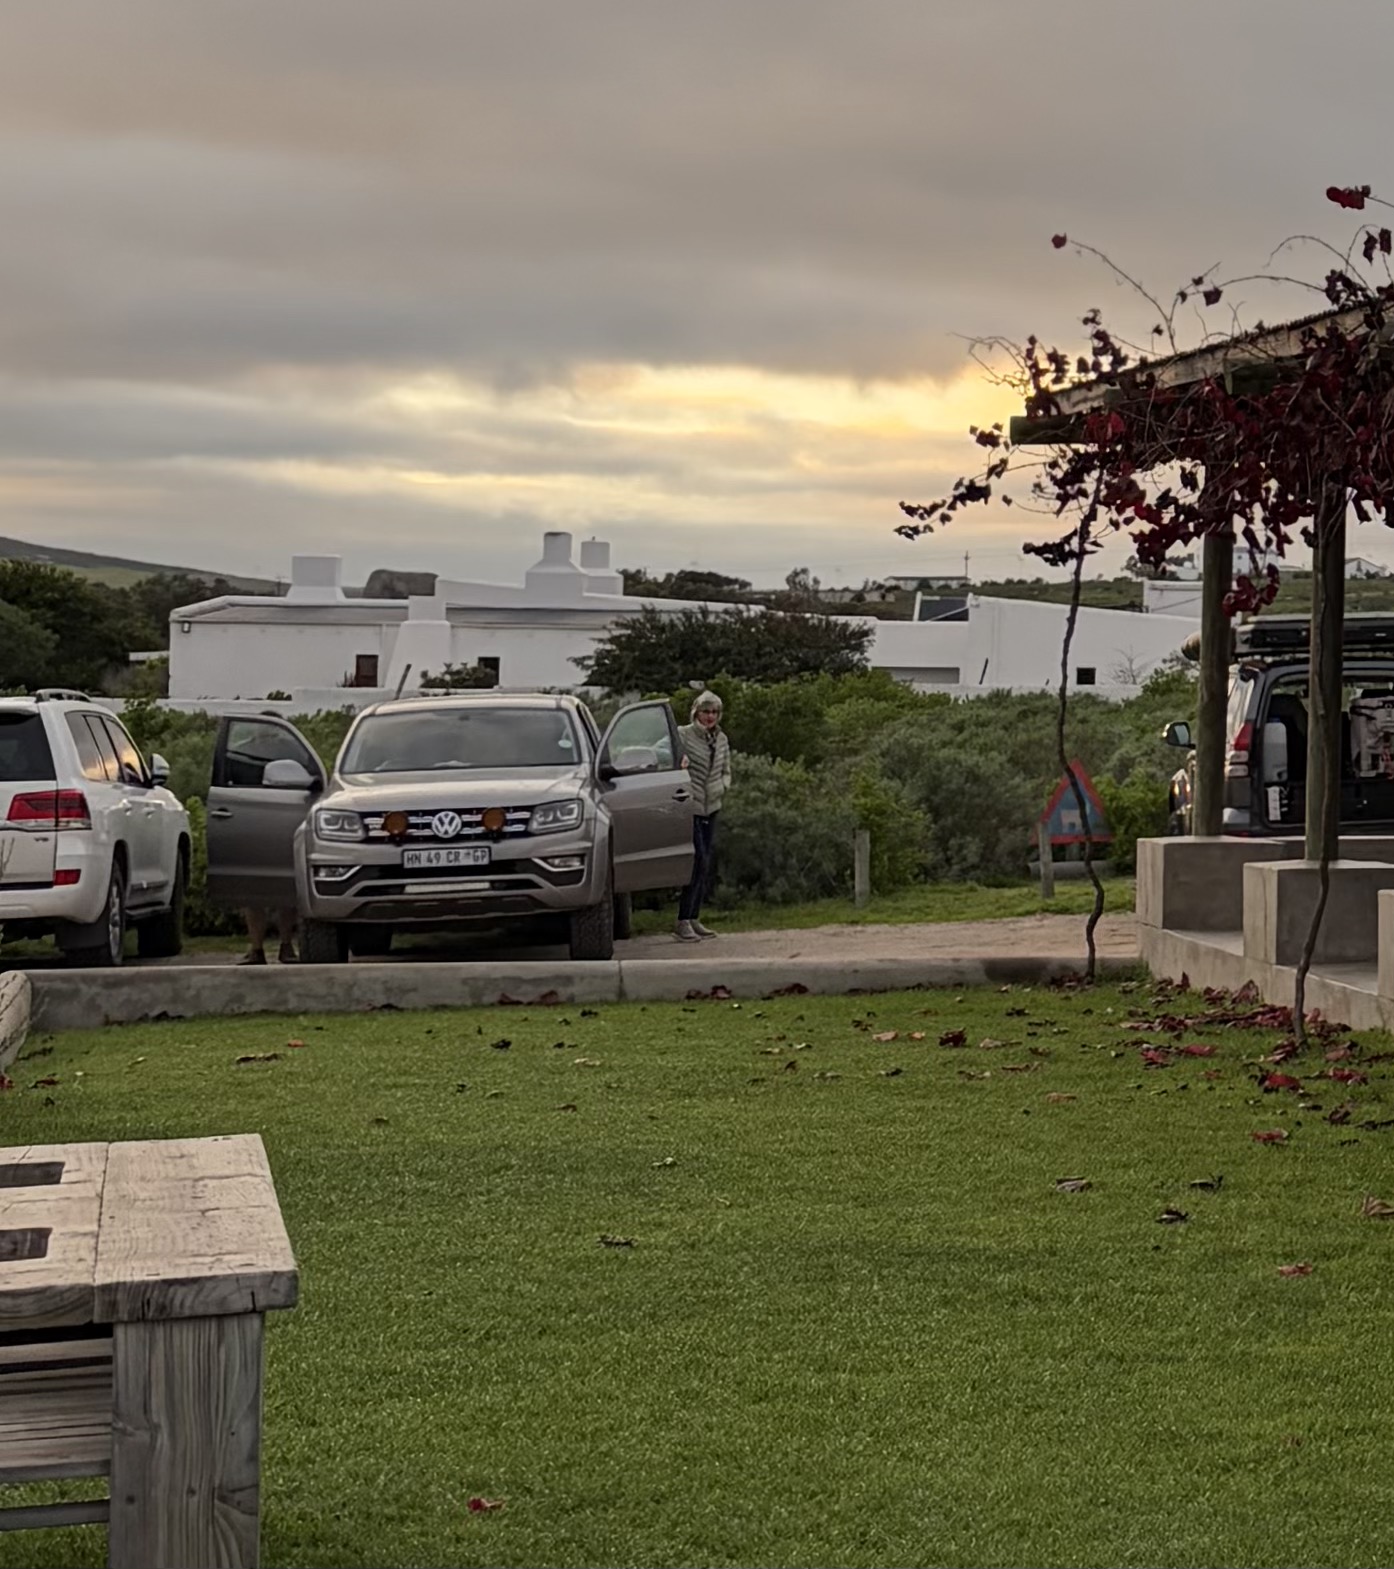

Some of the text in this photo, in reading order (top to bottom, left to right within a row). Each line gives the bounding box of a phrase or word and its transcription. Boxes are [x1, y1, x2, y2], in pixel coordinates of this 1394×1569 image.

[426, 852, 441, 864] 49
[446, 850, 461, 863] CR
[472, 849, 487, 863] GP
